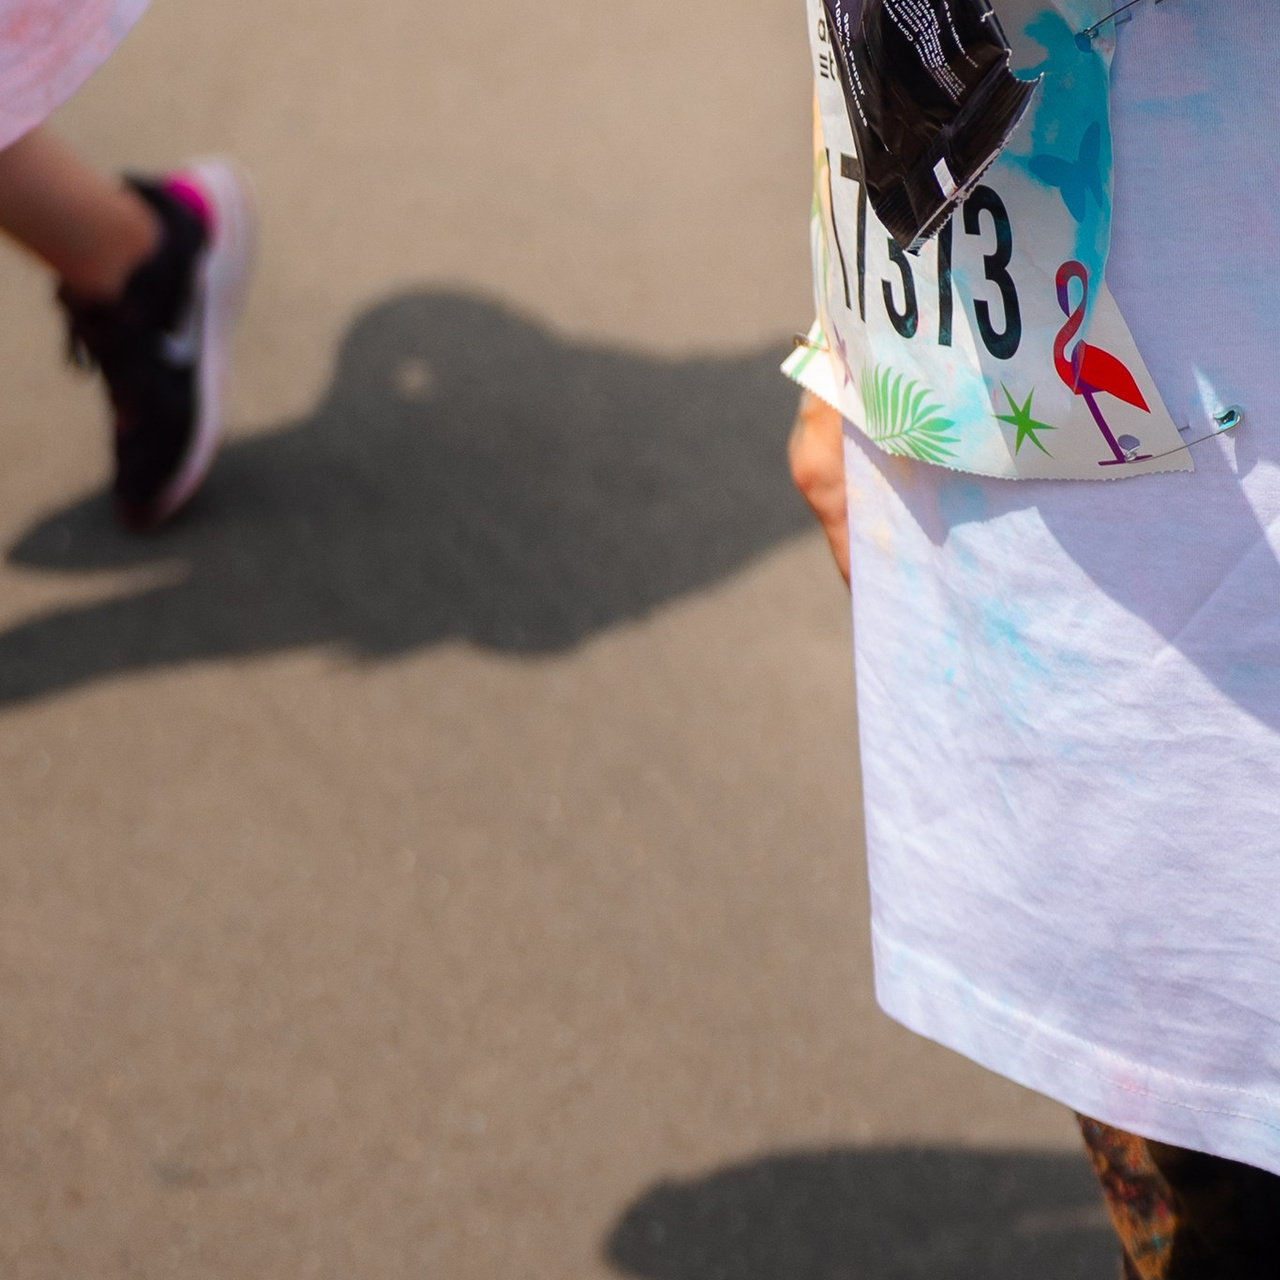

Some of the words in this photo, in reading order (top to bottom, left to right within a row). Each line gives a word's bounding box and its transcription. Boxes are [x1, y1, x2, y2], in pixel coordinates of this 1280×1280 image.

[835, 0, 843, 42] 100%
[894, 3, 918, 32] product
[897, 22, 914, 42] Corn
